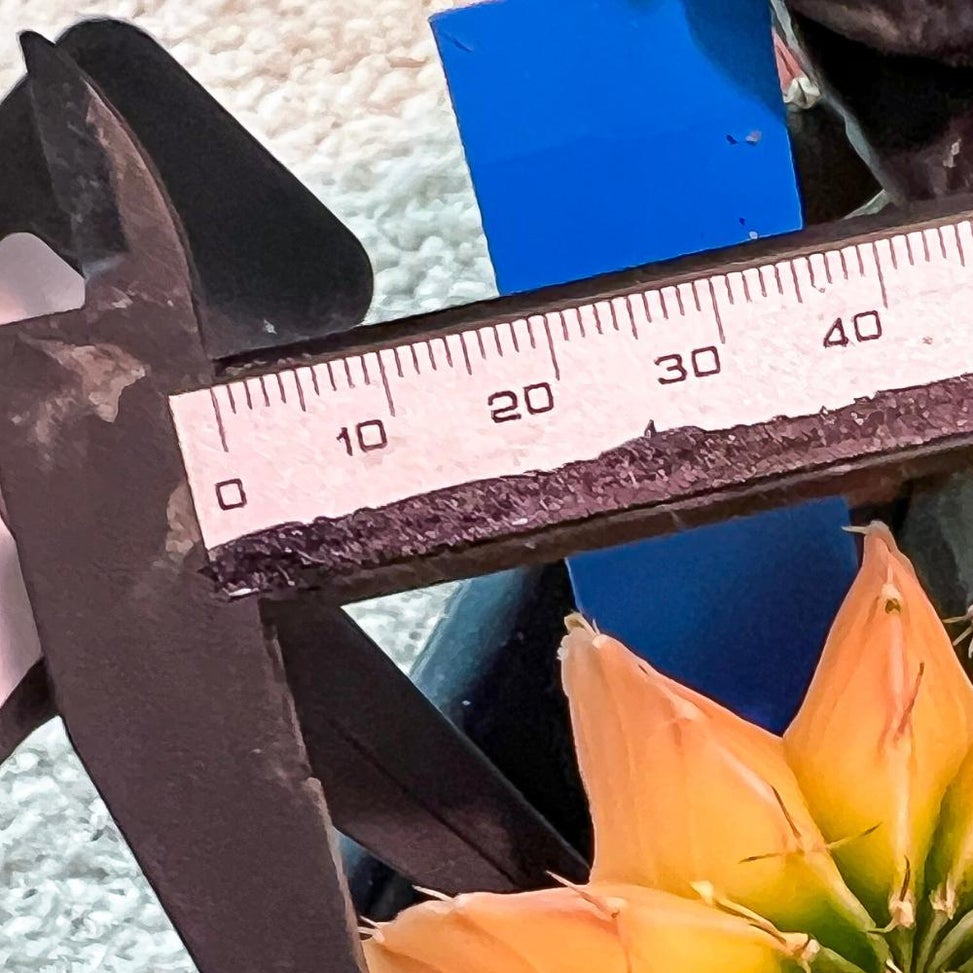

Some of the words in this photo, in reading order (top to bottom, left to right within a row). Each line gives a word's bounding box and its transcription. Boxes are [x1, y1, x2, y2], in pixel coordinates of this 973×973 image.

[215, 478, 247, 511] 0
[336, 419, 388, 456] 10
[487, 381, 554, 424] 20
[654, 346, 721, 385] 30
[823, 310, 883, 348] 40
